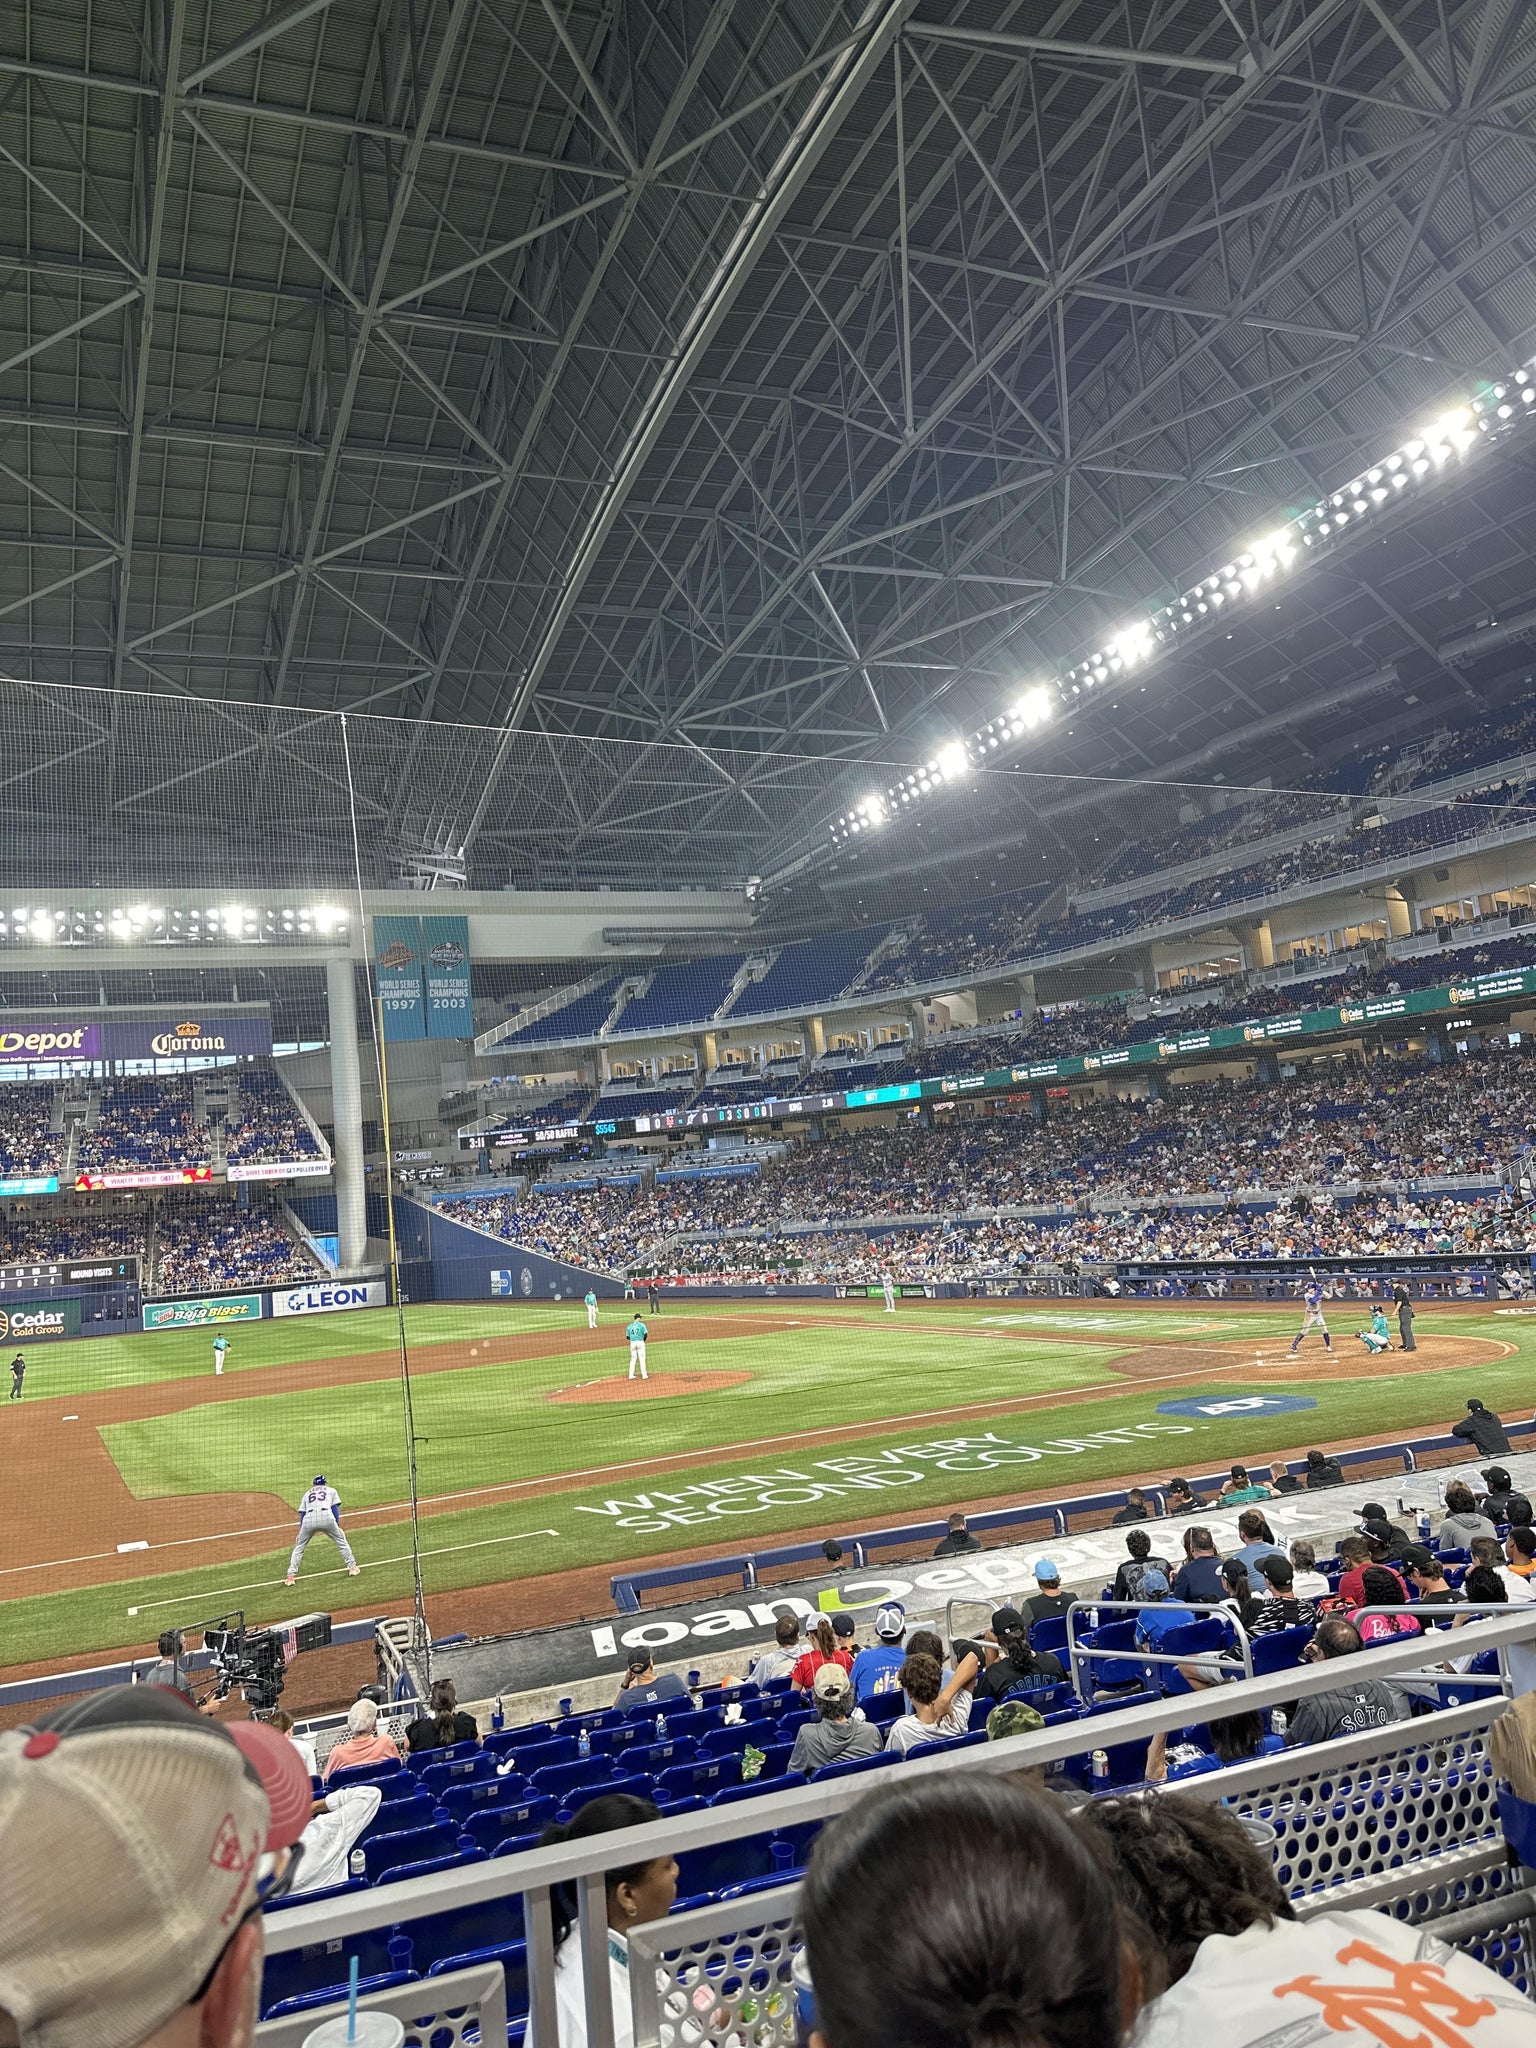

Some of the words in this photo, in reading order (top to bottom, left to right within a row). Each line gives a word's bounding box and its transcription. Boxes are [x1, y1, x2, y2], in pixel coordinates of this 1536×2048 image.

[380, 980, 399, 989] WORLD
[400, 979, 420, 989] SERIES
[429, 979, 449, 988] WORLD
[449, 978, 468, 987] SERIES
[380, 989, 420, 999] CHAMPIONS
[430, 988, 469, 997] CHAMPIONS
[385, 1000, 416, 1010] 1997
[433, 998, 466, 1009] 2003
[151, 1033, 225, 1056] Corona
[654, 1118, 661, 1129] 0
[702, 1112, 708, 1124] 0
[727, 1110, 733, 1120] 3
[535, 1130, 555, 1141] 50/50
[555, 1127, 578, 1139] RAFFLE
[469, 1137, 485, 1149] 3:11
[495, 1138, 528, 1146] FOUNDATION
[93, 1267, 113, 1277] VISITS
[119, 1265, 125, 1274] 2
[33, 1278, 38, 1286] 2
[50, 1277, 55, 1285] 4
[684, 1278, 700, 1286] THIS
[307, 1287, 367, 1308] LEON
[173, 1307, 208, 1321] Baja
[208, 1304, 249, 1317] Blast
[11, 1310, 64, 1328] Cedar
[12, 1326, 34, 1337] Gold
[35, 1325, 64, 1335] Group
[1196, 1396, 1285, 1416] ADT
[573, 1468, 815, 1516] WHEN
[812, 1433, 1013, 1474] EVERY
[616, 1469, 925, 1534] SECOND
[936, 1423, 1210, 1471] COUNTS.
[308, 1490, 326, 1503] 63
[1341, 1705, 1388, 1732] SOTO
